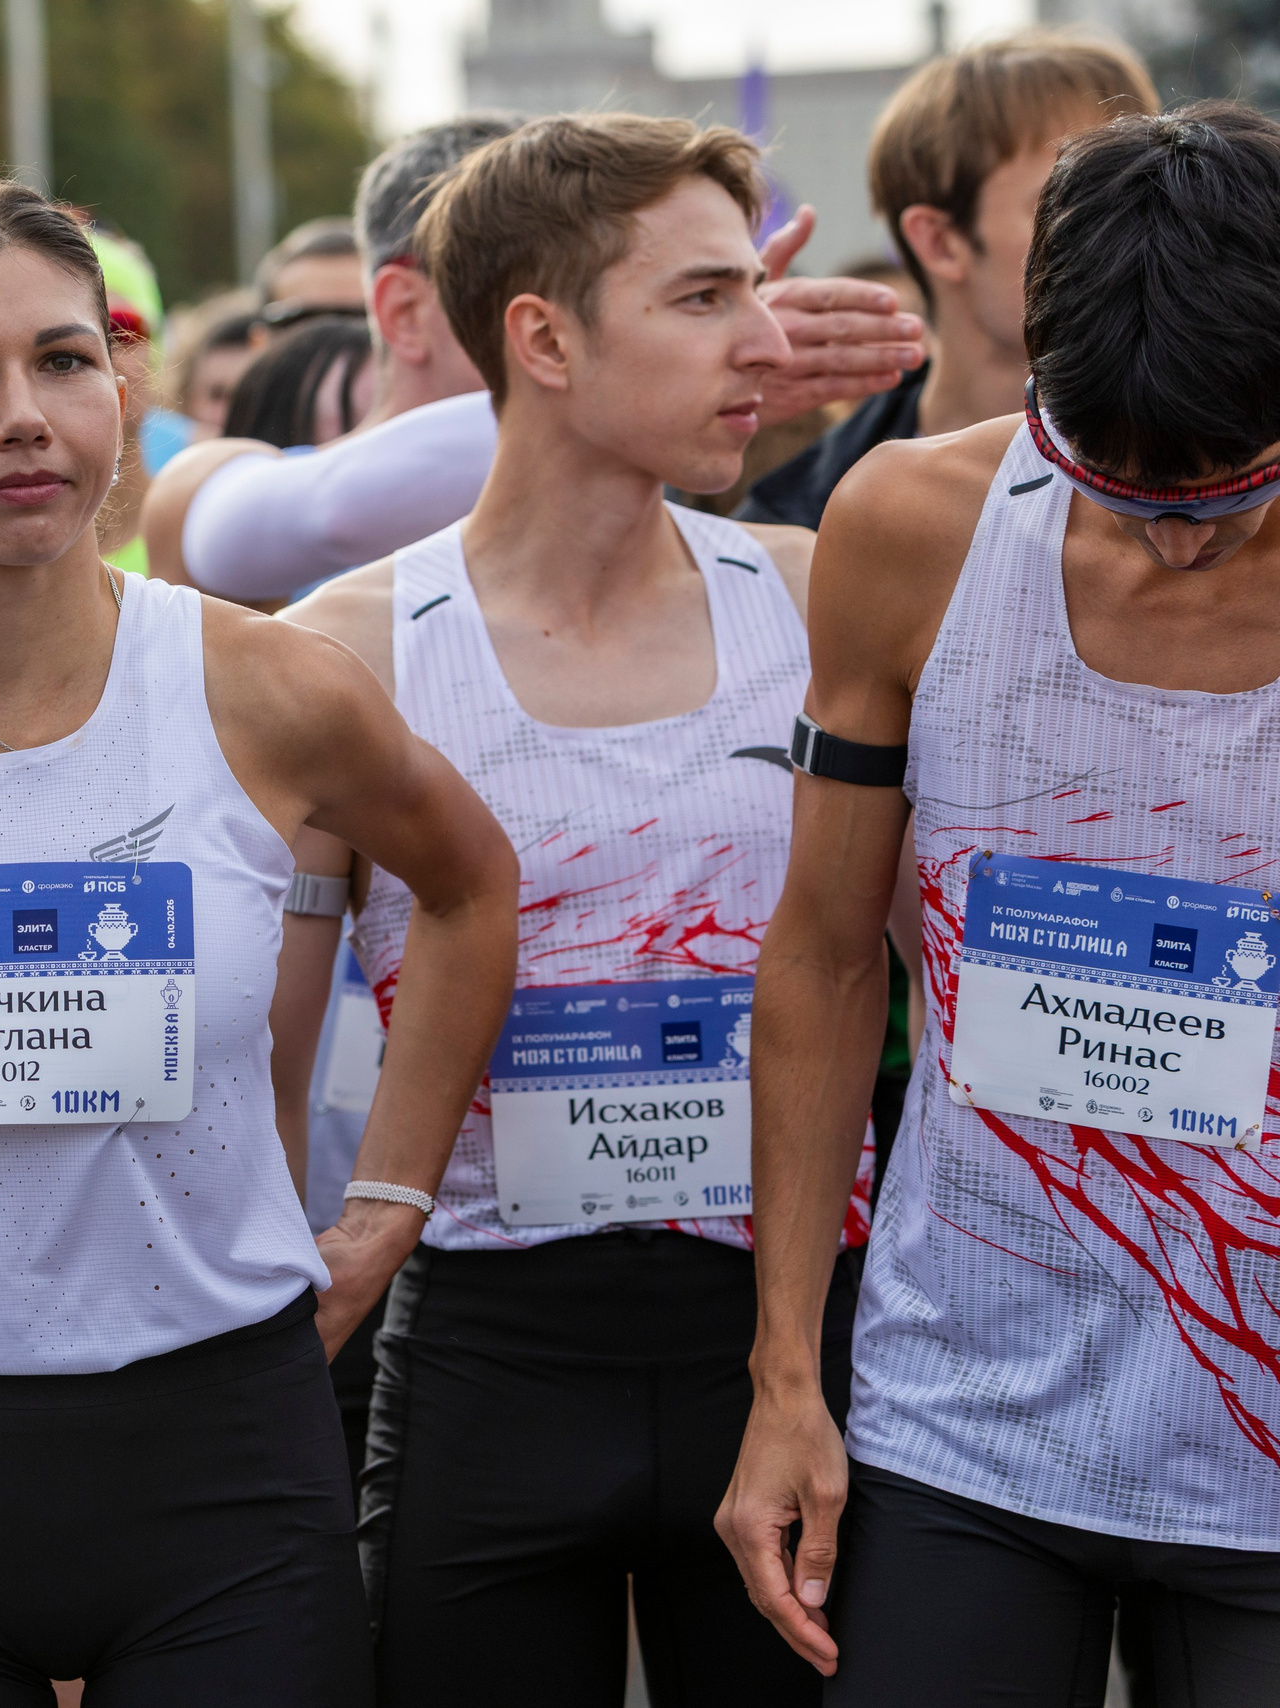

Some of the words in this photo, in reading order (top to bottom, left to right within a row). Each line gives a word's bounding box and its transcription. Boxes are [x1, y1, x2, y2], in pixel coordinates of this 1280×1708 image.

[37, 882, 74, 891] формэко
[98, 881, 126, 893] ПСБ
[1181, 901, 1218, 912] формэко
[1240, 908, 1270, 923] ПСБ
[166, 898, 175, 949] 04.10.2026
[992, 905, 1004, 916] IX
[1005, 907, 1099, 929] ПОЛУМАРАФОН
[17, 923, 54, 933] ЭЛИТА
[18, 944, 53, 952] КЛАСТЕР
[990, 921, 1029, 943] МОЯ
[1033, 928, 1128, 958] СТОЛИЦА
[1155, 938, 1192, 952] ЭЛИТА
[1154, 959, 1189, 971] КЛАСТЕР
[1020, 982, 1226, 1040] Ахмадеев
[164, 1013, 179, 1081] МОСКВА
[524, 1030, 612, 1044] ПОЛУМАРАФОН
[513, 1049, 551, 1067] МОЯ
[553, 1044, 642, 1064] СТОЛИЦА
[1057, 1025, 1182, 1073] Ринас
[1083, 1069, 1150, 1096] 16002
[568, 1097, 725, 1125] Исхаков
[588, 1133, 708, 1163] Айдар
[626, 1166, 676, 1183] 16011
